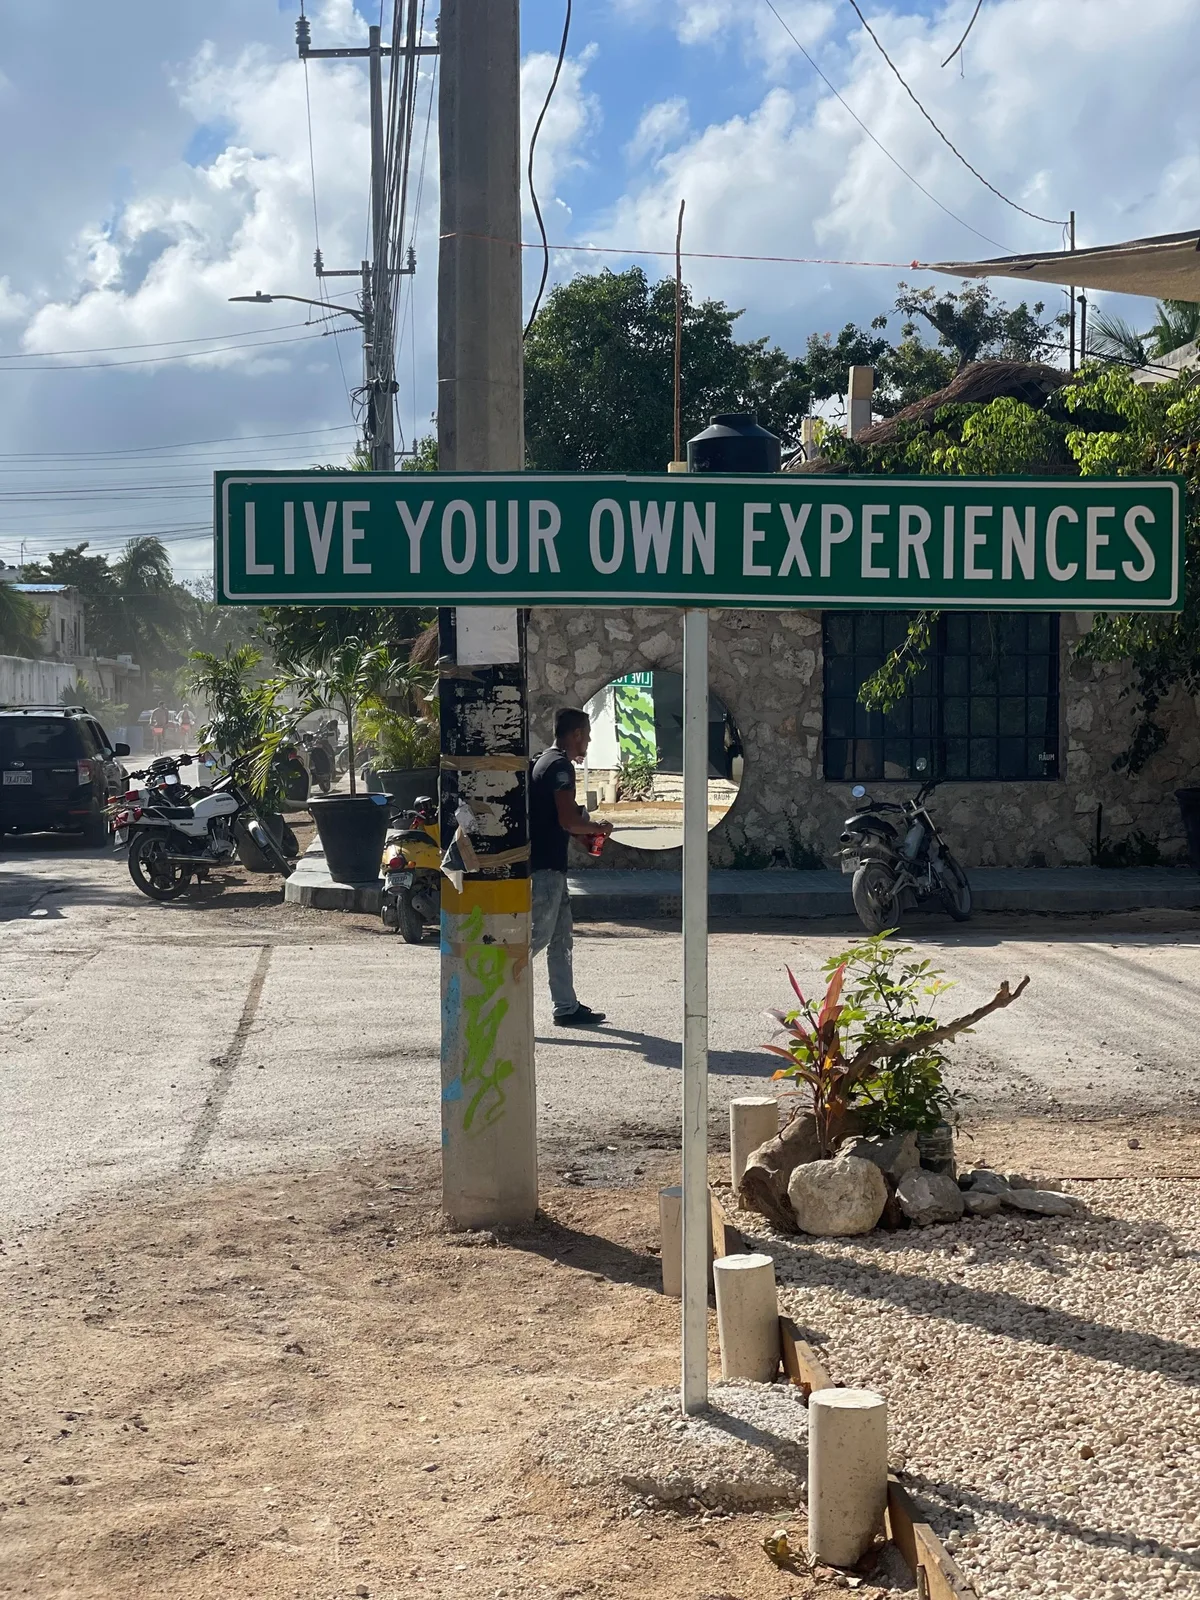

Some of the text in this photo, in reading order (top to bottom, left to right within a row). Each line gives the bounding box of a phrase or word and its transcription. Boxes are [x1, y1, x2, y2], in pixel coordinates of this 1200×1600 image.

[245, 498, 1156, 582] LIVE YOUR OWN EXPERIENCES
